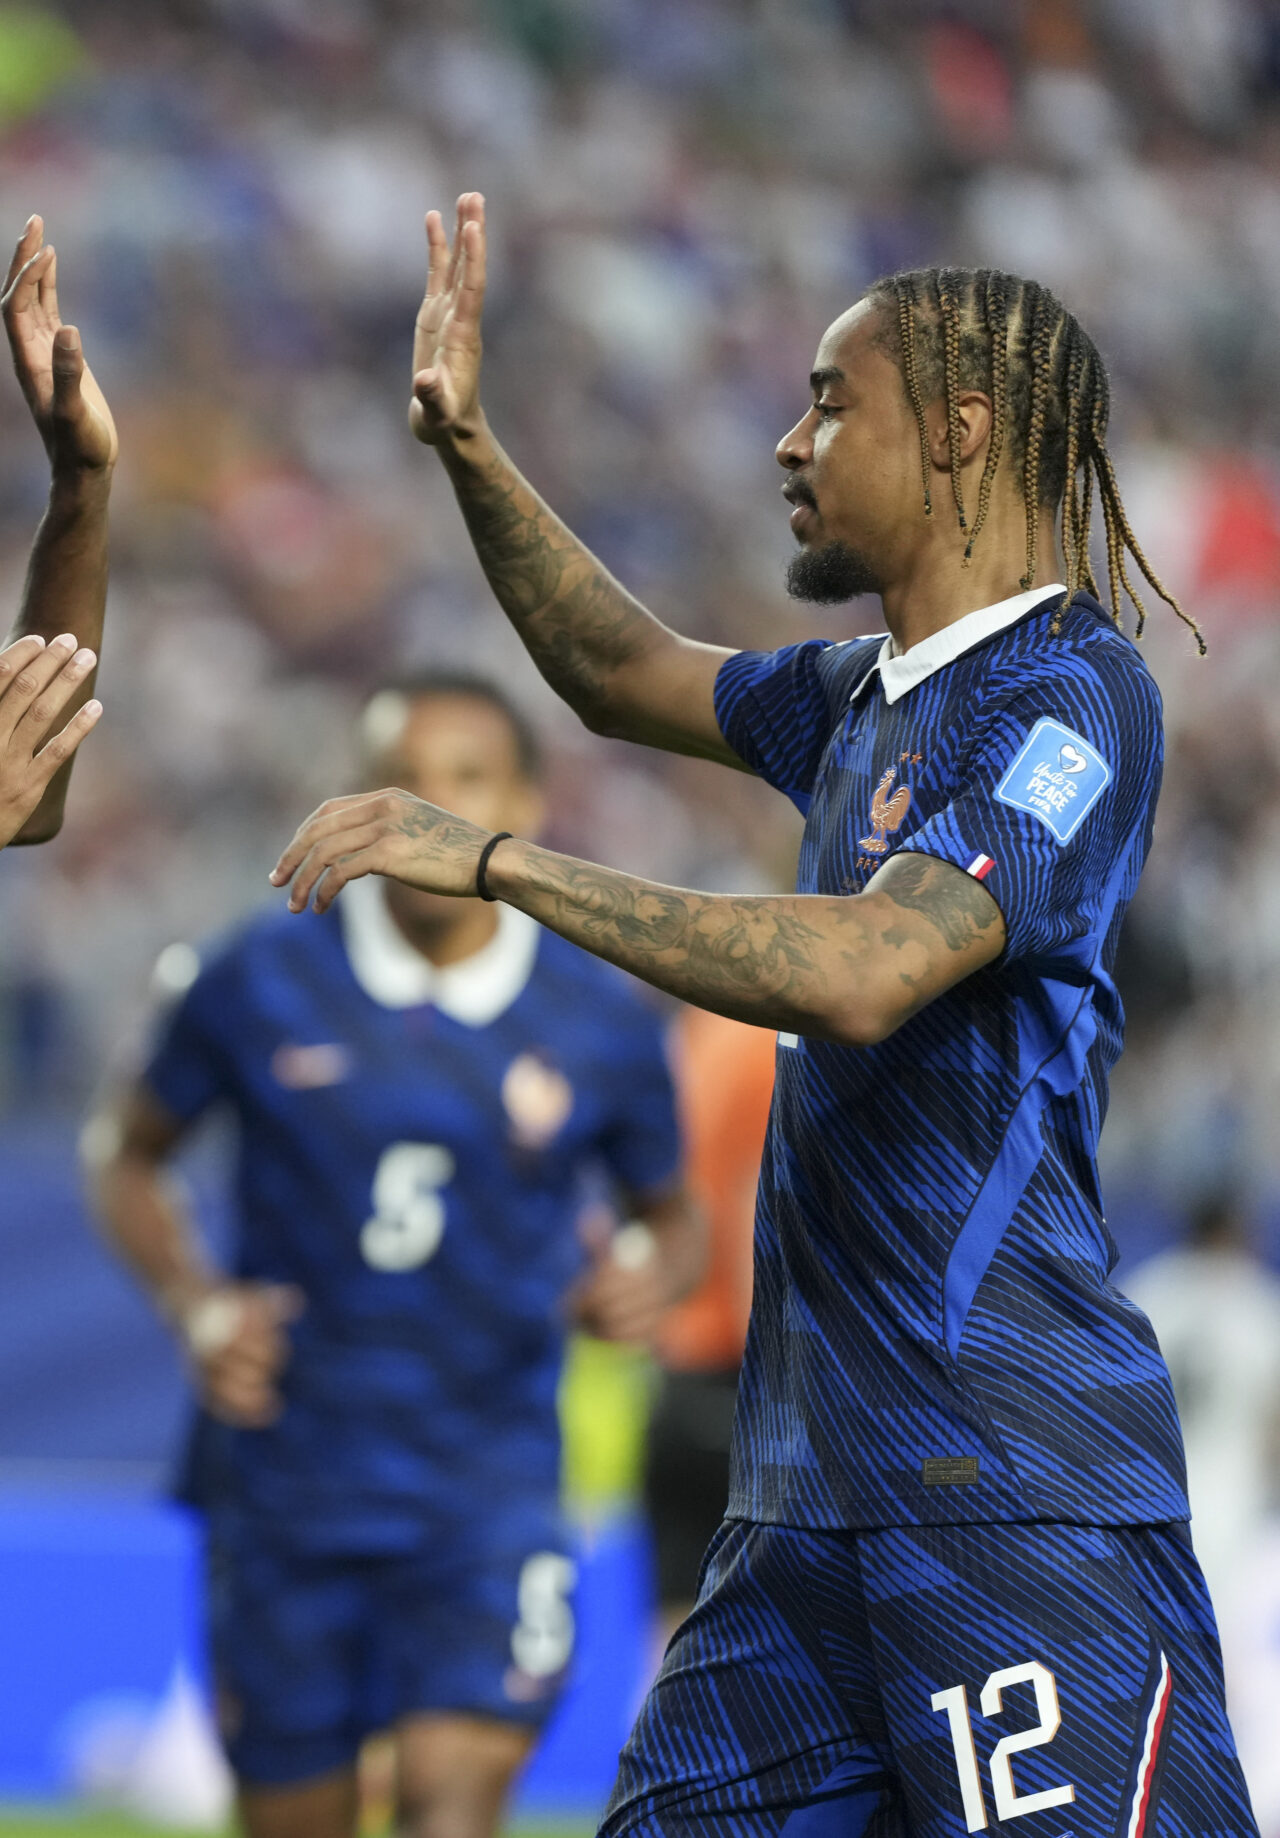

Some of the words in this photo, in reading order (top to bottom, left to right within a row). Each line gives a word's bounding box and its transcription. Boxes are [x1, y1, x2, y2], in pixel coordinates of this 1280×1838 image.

[1026, 776, 1069, 813] PEACE
[1027, 795, 1051, 814] FIFA
[360, 1140, 456, 1273] 5
[511, 1551, 578, 1676] 5
[930, 1660, 1076, 1834] 12
